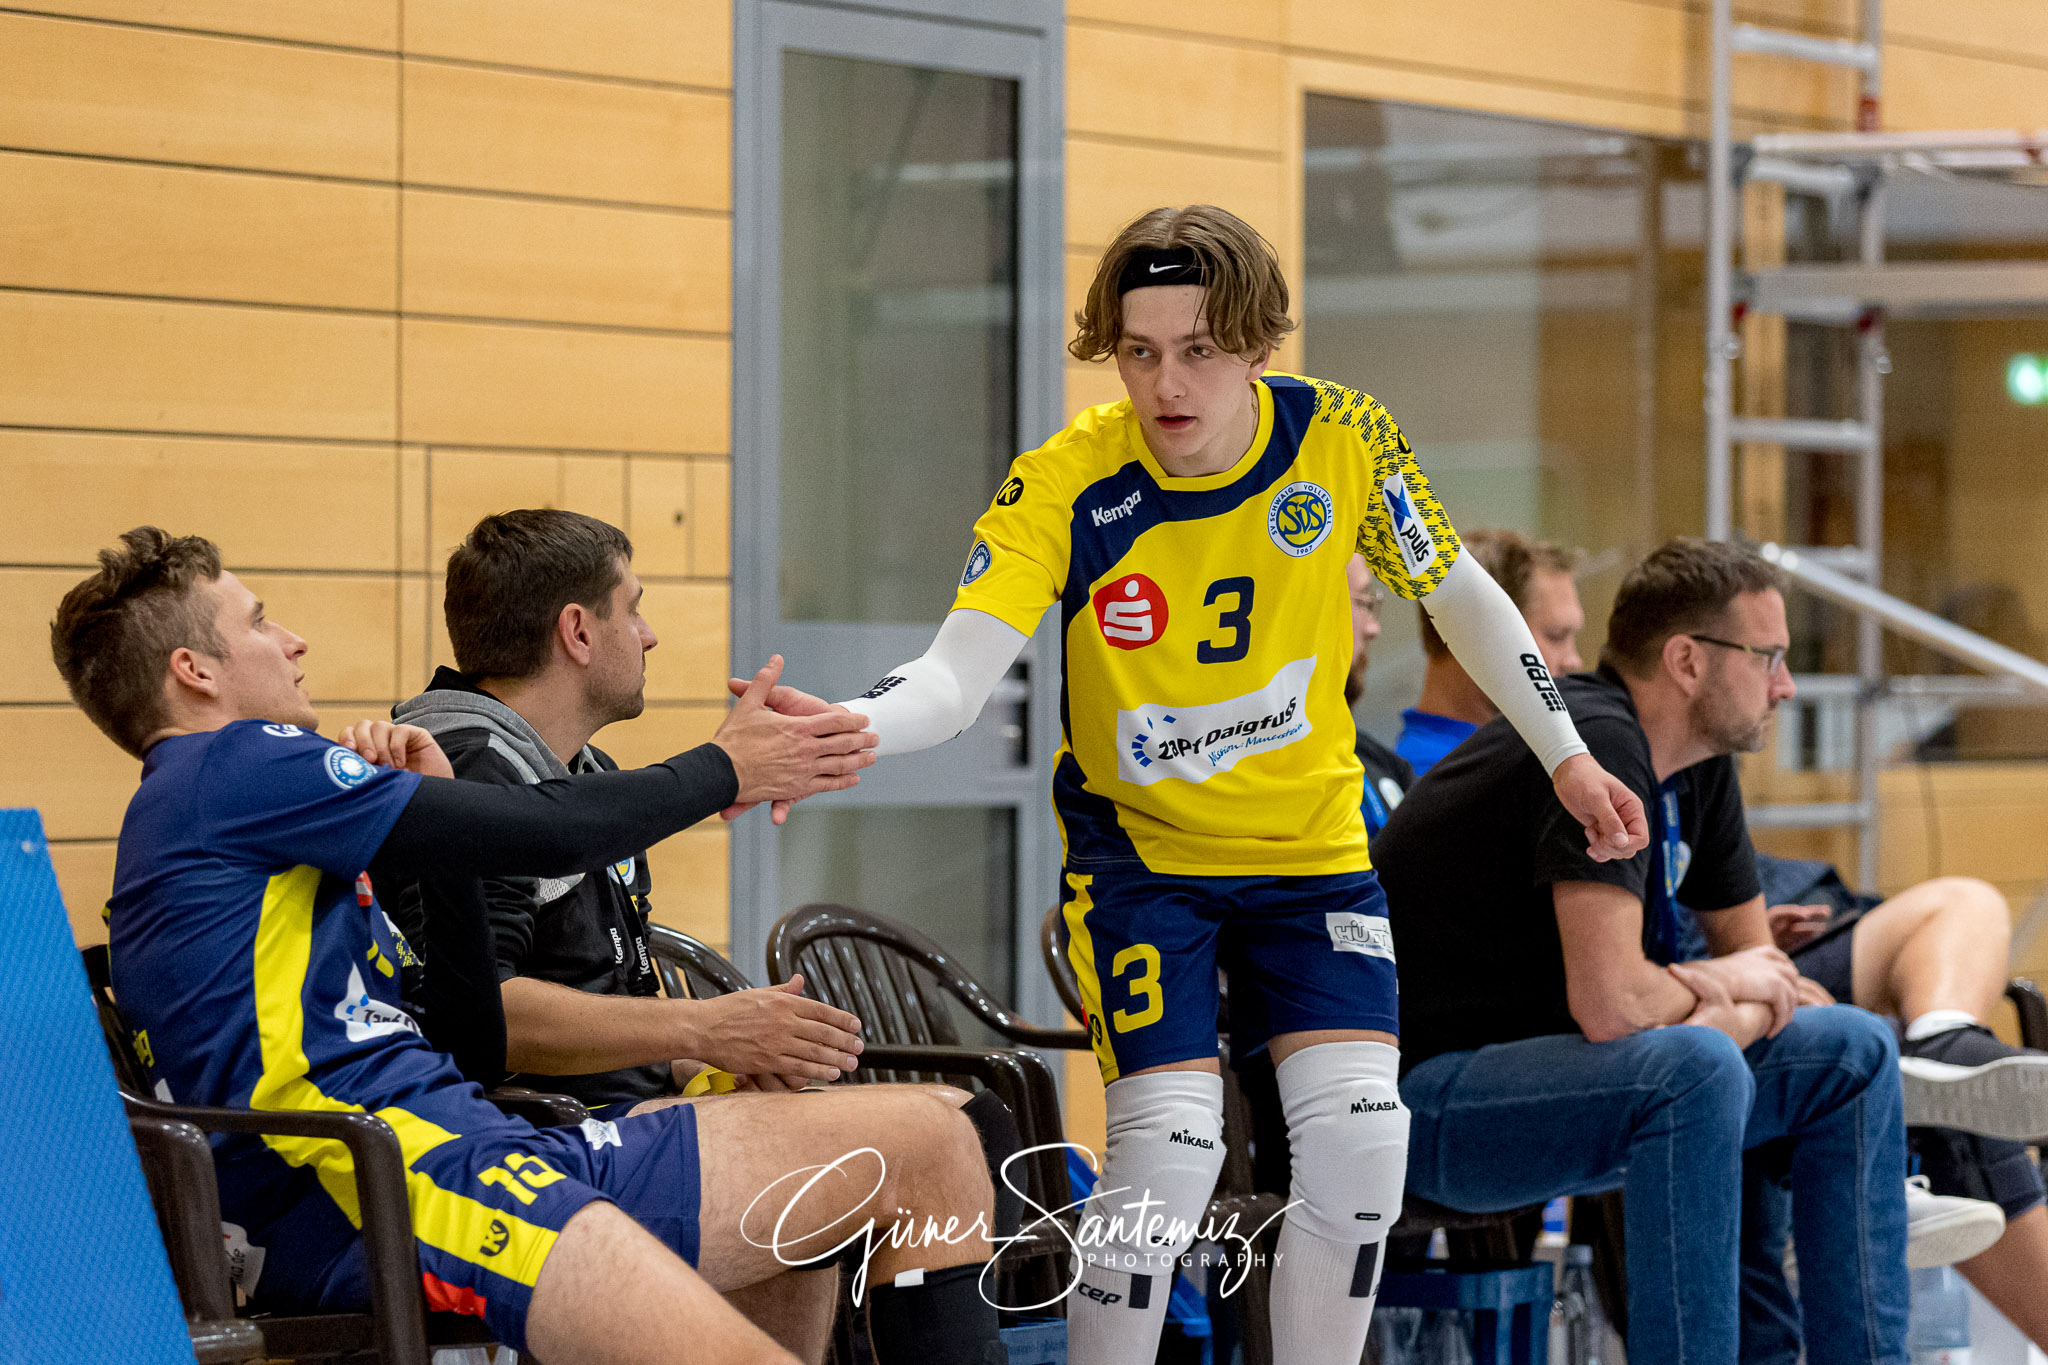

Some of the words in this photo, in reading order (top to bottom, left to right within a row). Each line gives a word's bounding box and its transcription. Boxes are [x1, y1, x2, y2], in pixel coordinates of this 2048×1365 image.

[1091, 490, 1142, 527] Kempa
[1269, 487, 1294, 522] SCHWAIG
[1303, 484, 1332, 525] VOLLEYBALL
[1269, 525, 1278, 536] SV
[1400, 523, 1430, 563] puls
[1296, 545, 1313, 555] 1967
[1196, 576, 1255, 664] 3
[1204, 696, 1297, 748] Daigfuss
[609, 927, 624, 964] Kempa
[635, 936, 651, 975] Kempa
[1112, 943, 1164, 1034] 3
[1350, 1097, 1398, 1115] MIKASA
[1169, 1129, 1215, 1151] MIKASA
[1077, 1281, 1122, 1306] cep
